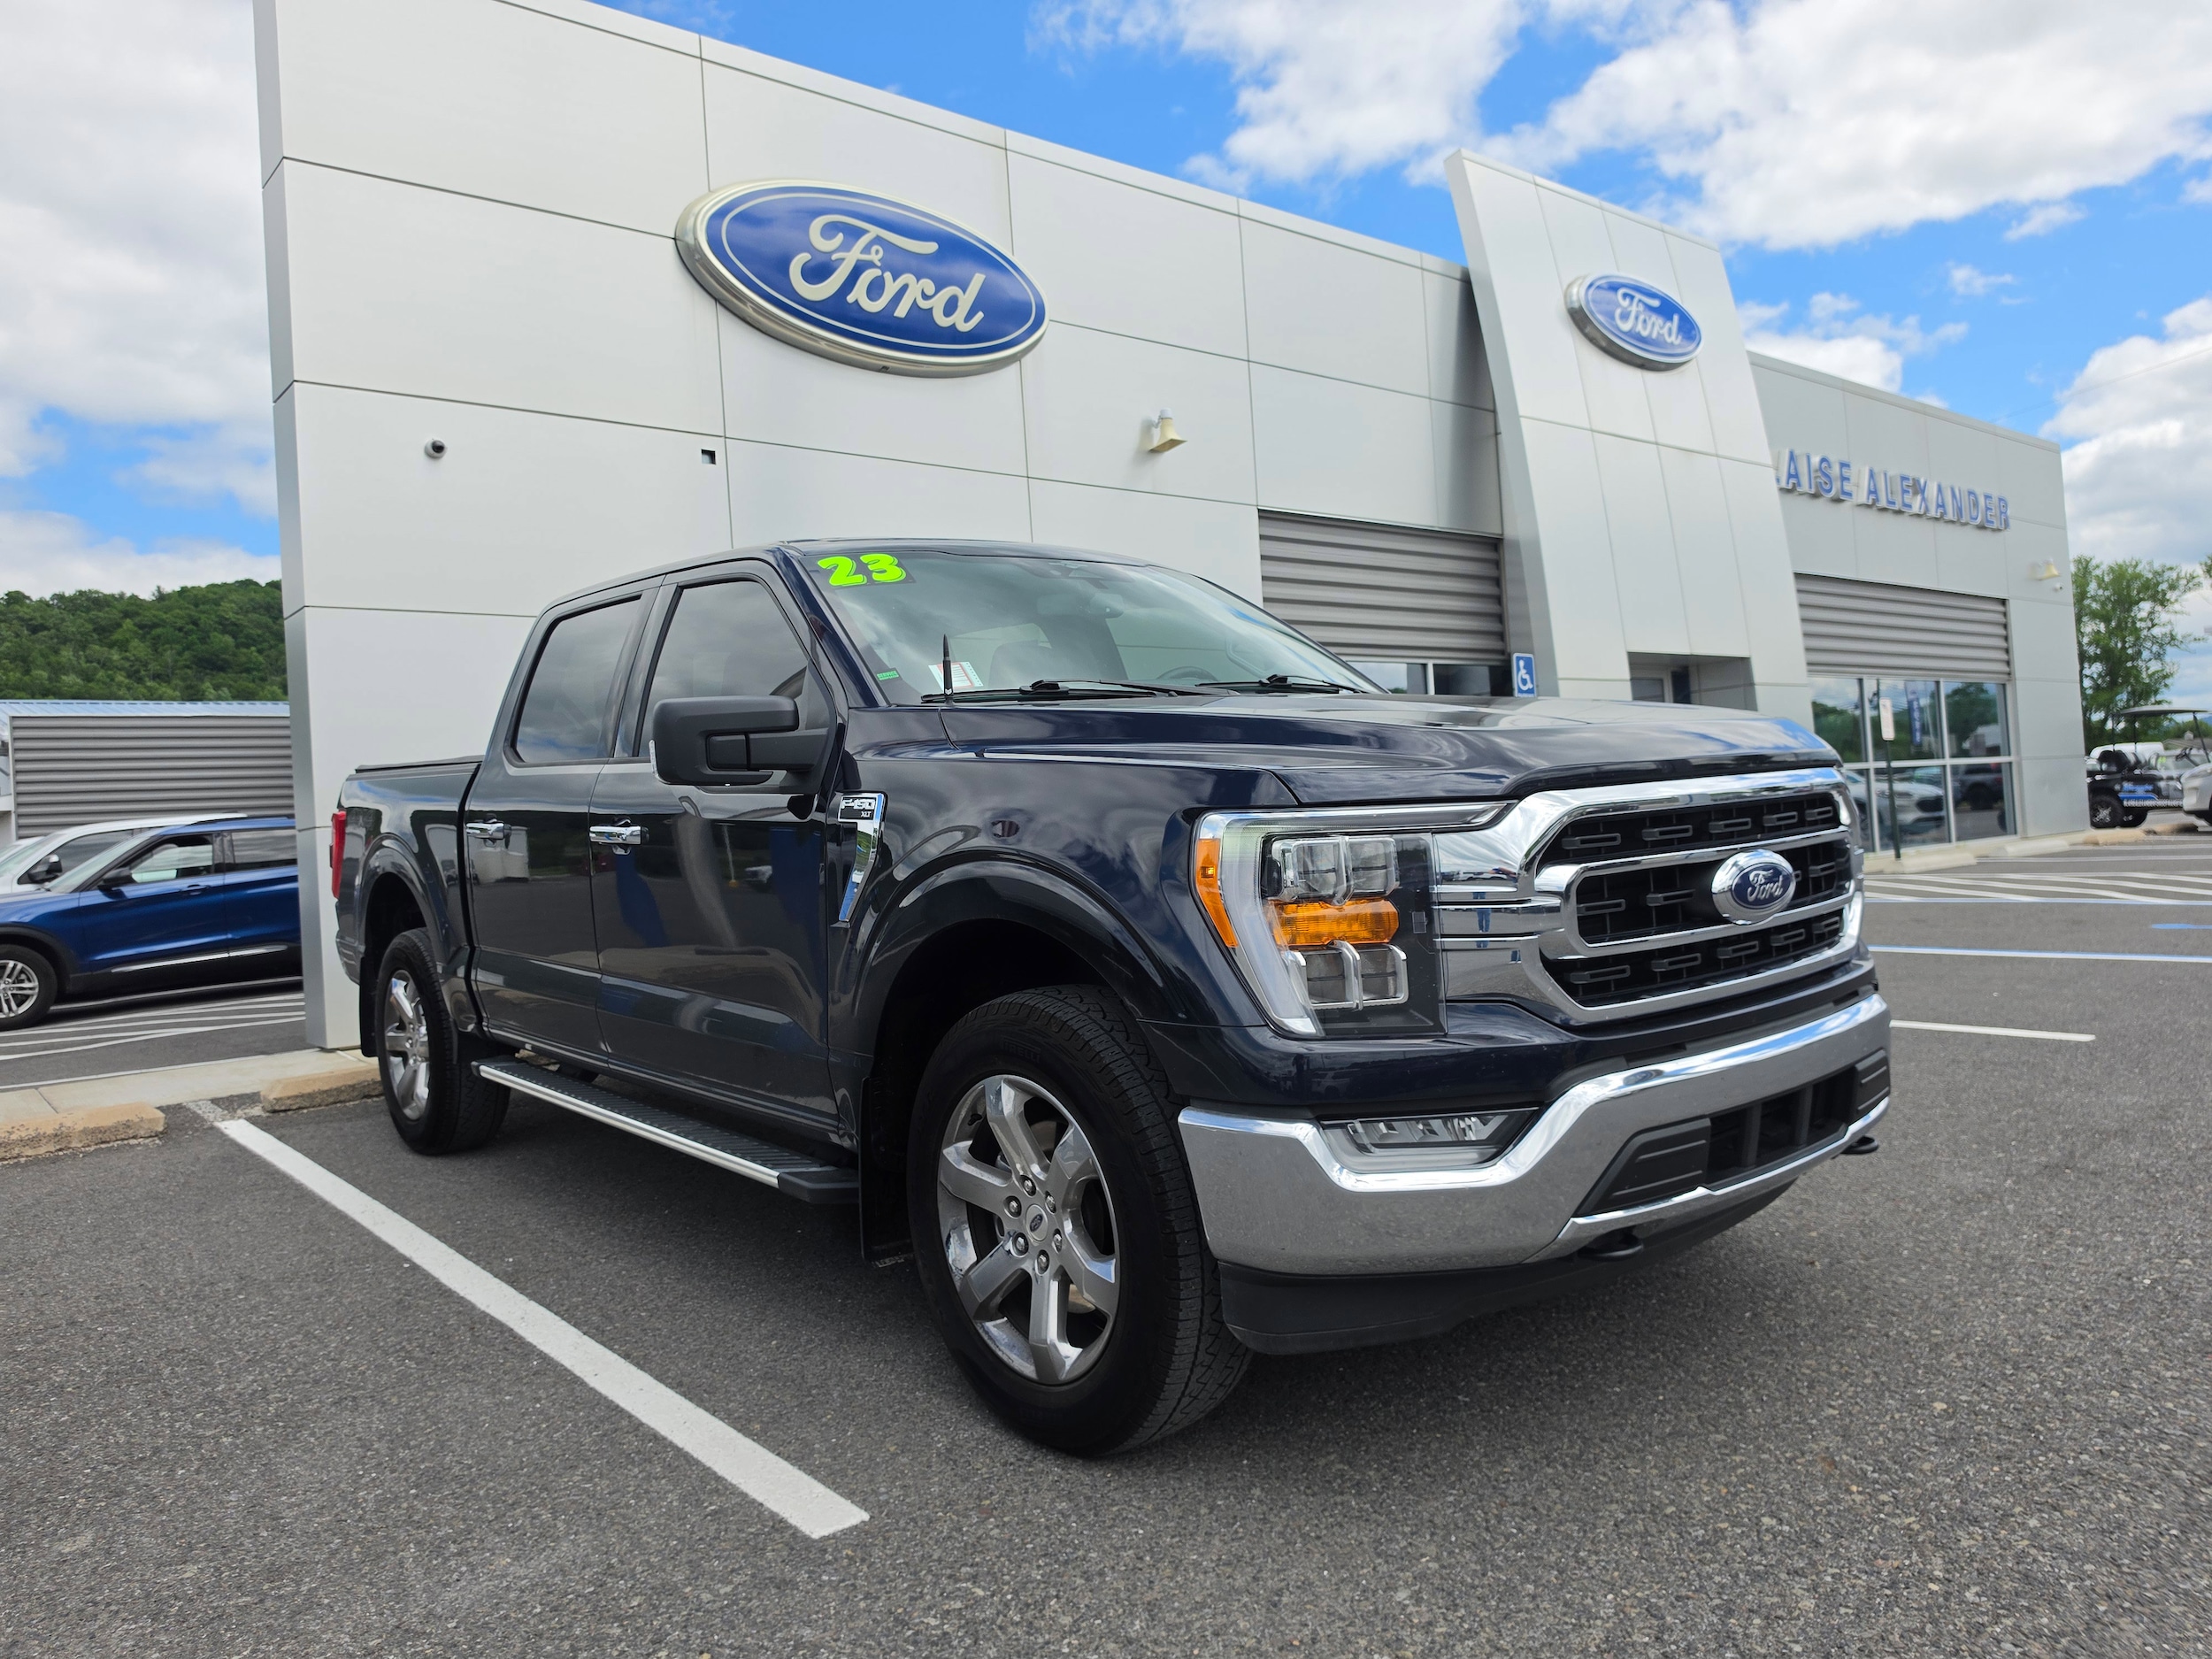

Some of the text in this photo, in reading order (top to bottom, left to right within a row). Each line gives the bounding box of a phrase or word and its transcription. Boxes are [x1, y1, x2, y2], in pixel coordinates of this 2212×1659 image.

[789, 214, 986, 332] Ford
[1614, 287, 1683, 345] Ford
[1775, 449, 2011, 530] AISE ALEXANDER
[817, 553, 906, 587] 23
[841, 798, 876, 810] F-150
[1747, 869, 1784, 902] Ford
